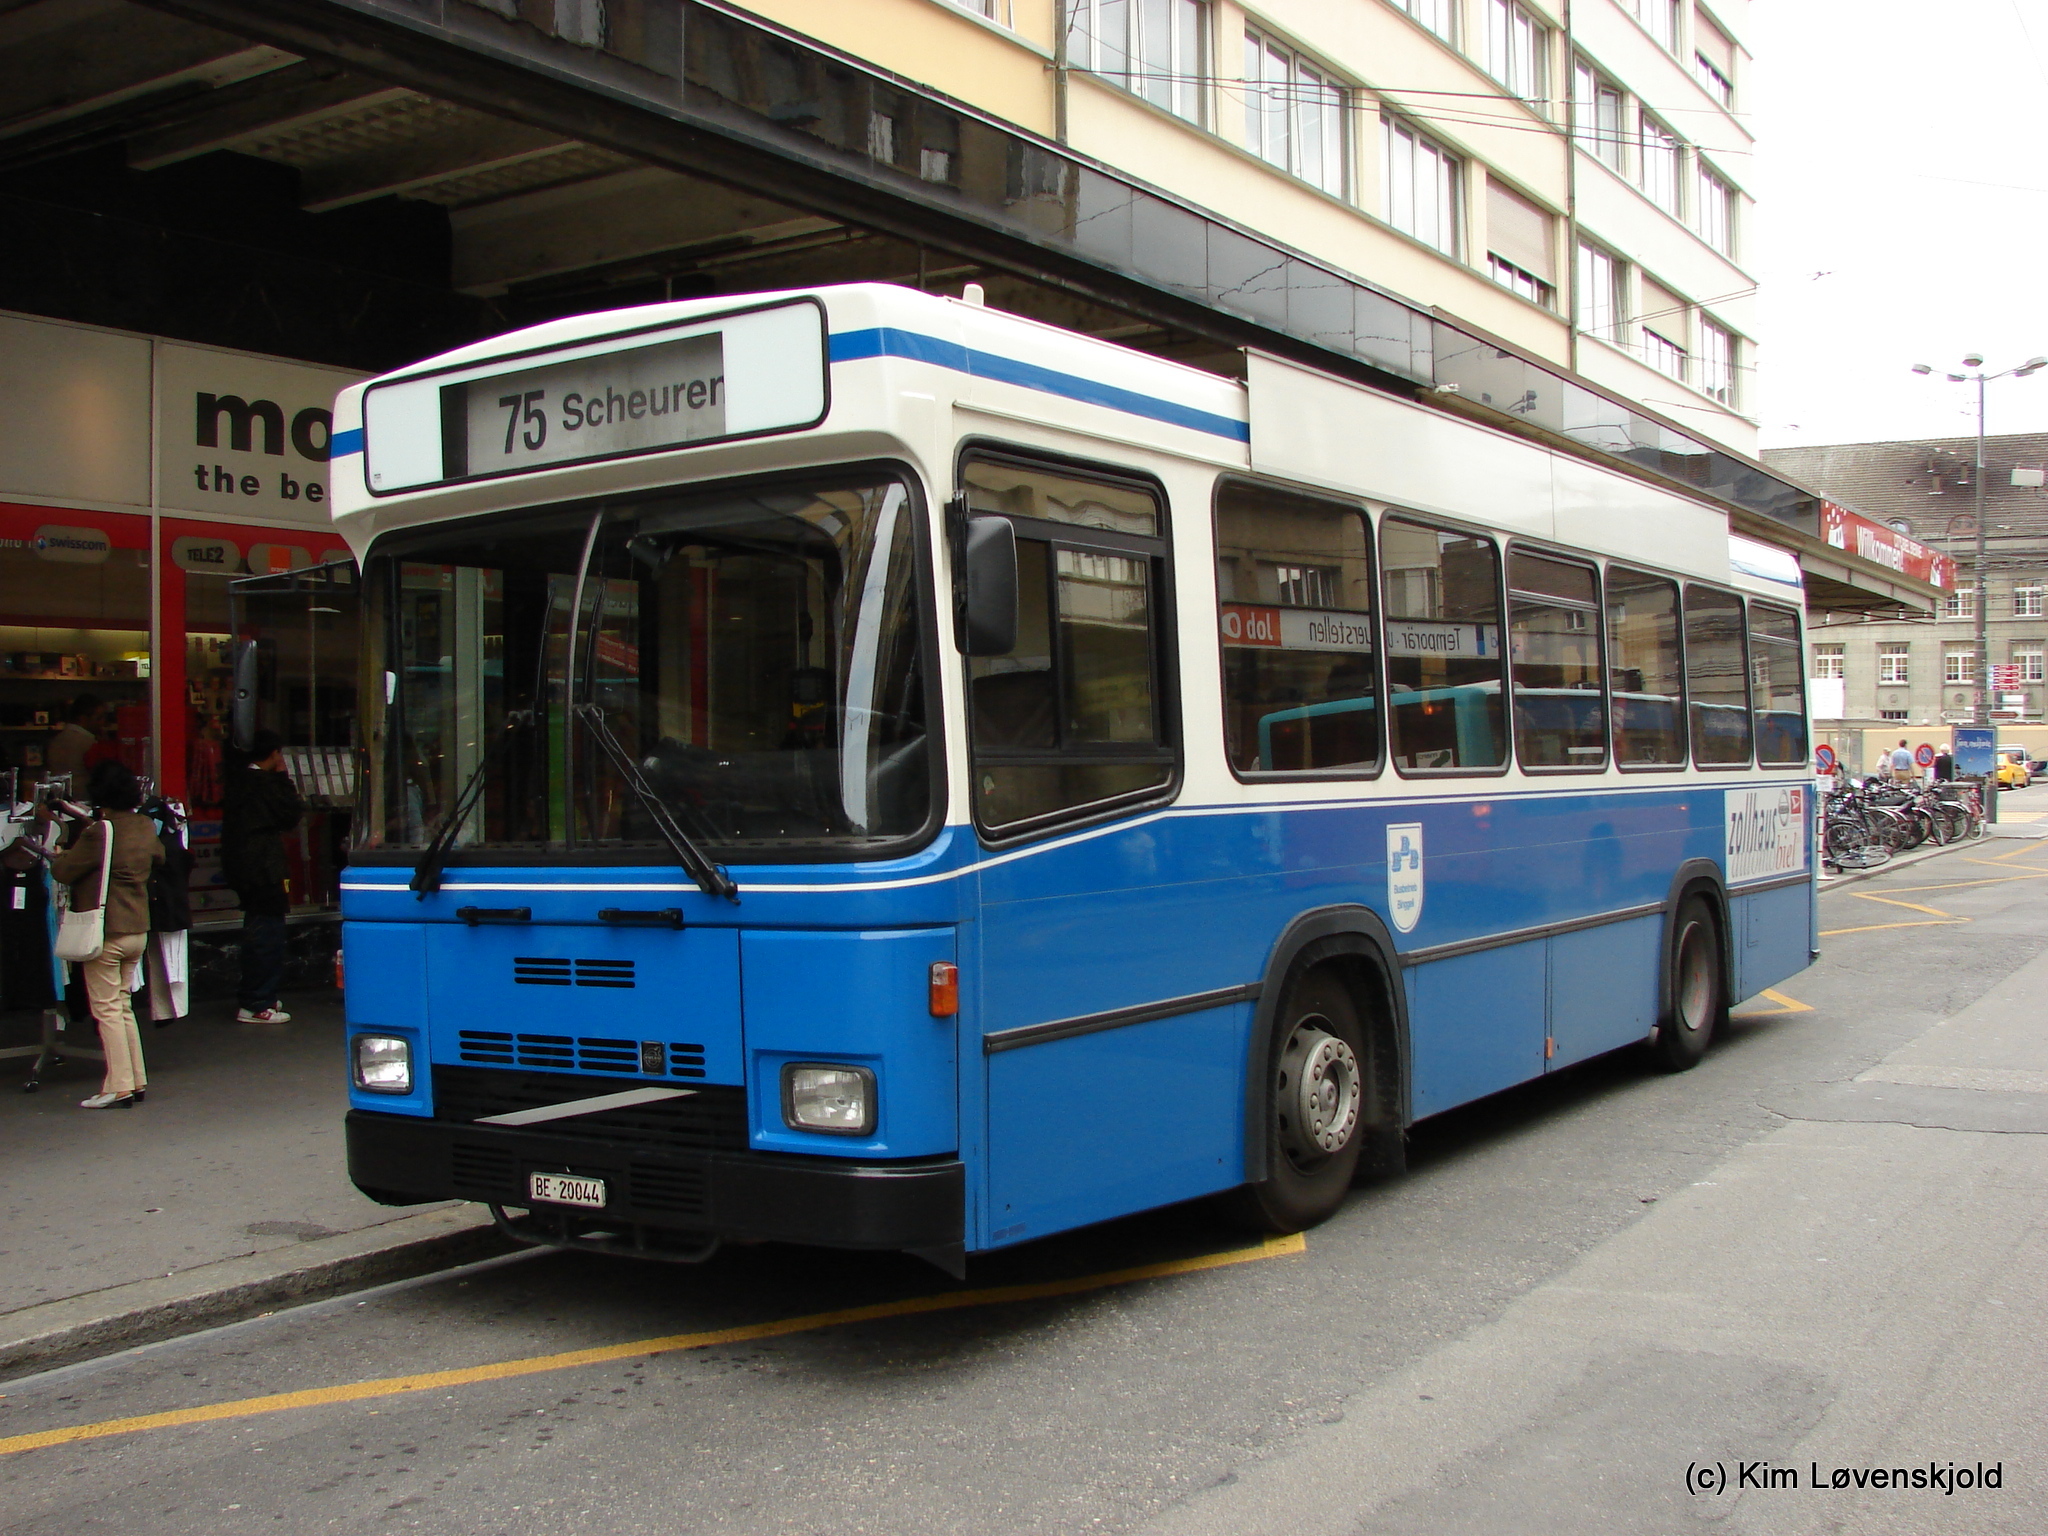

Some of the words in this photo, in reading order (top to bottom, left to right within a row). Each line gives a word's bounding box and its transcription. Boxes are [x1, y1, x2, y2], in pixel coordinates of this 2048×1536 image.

[499, 389, 548, 455] 75
[194, 464, 260, 495] the
[49, 535, 107, 551] swisscom
[187, 546, 225, 564] TELE2
[1728, 792, 1777, 855] zollhaus
[535, 1177, 551, 1197] BE
[559, 1180, 600, 1203] 20044
